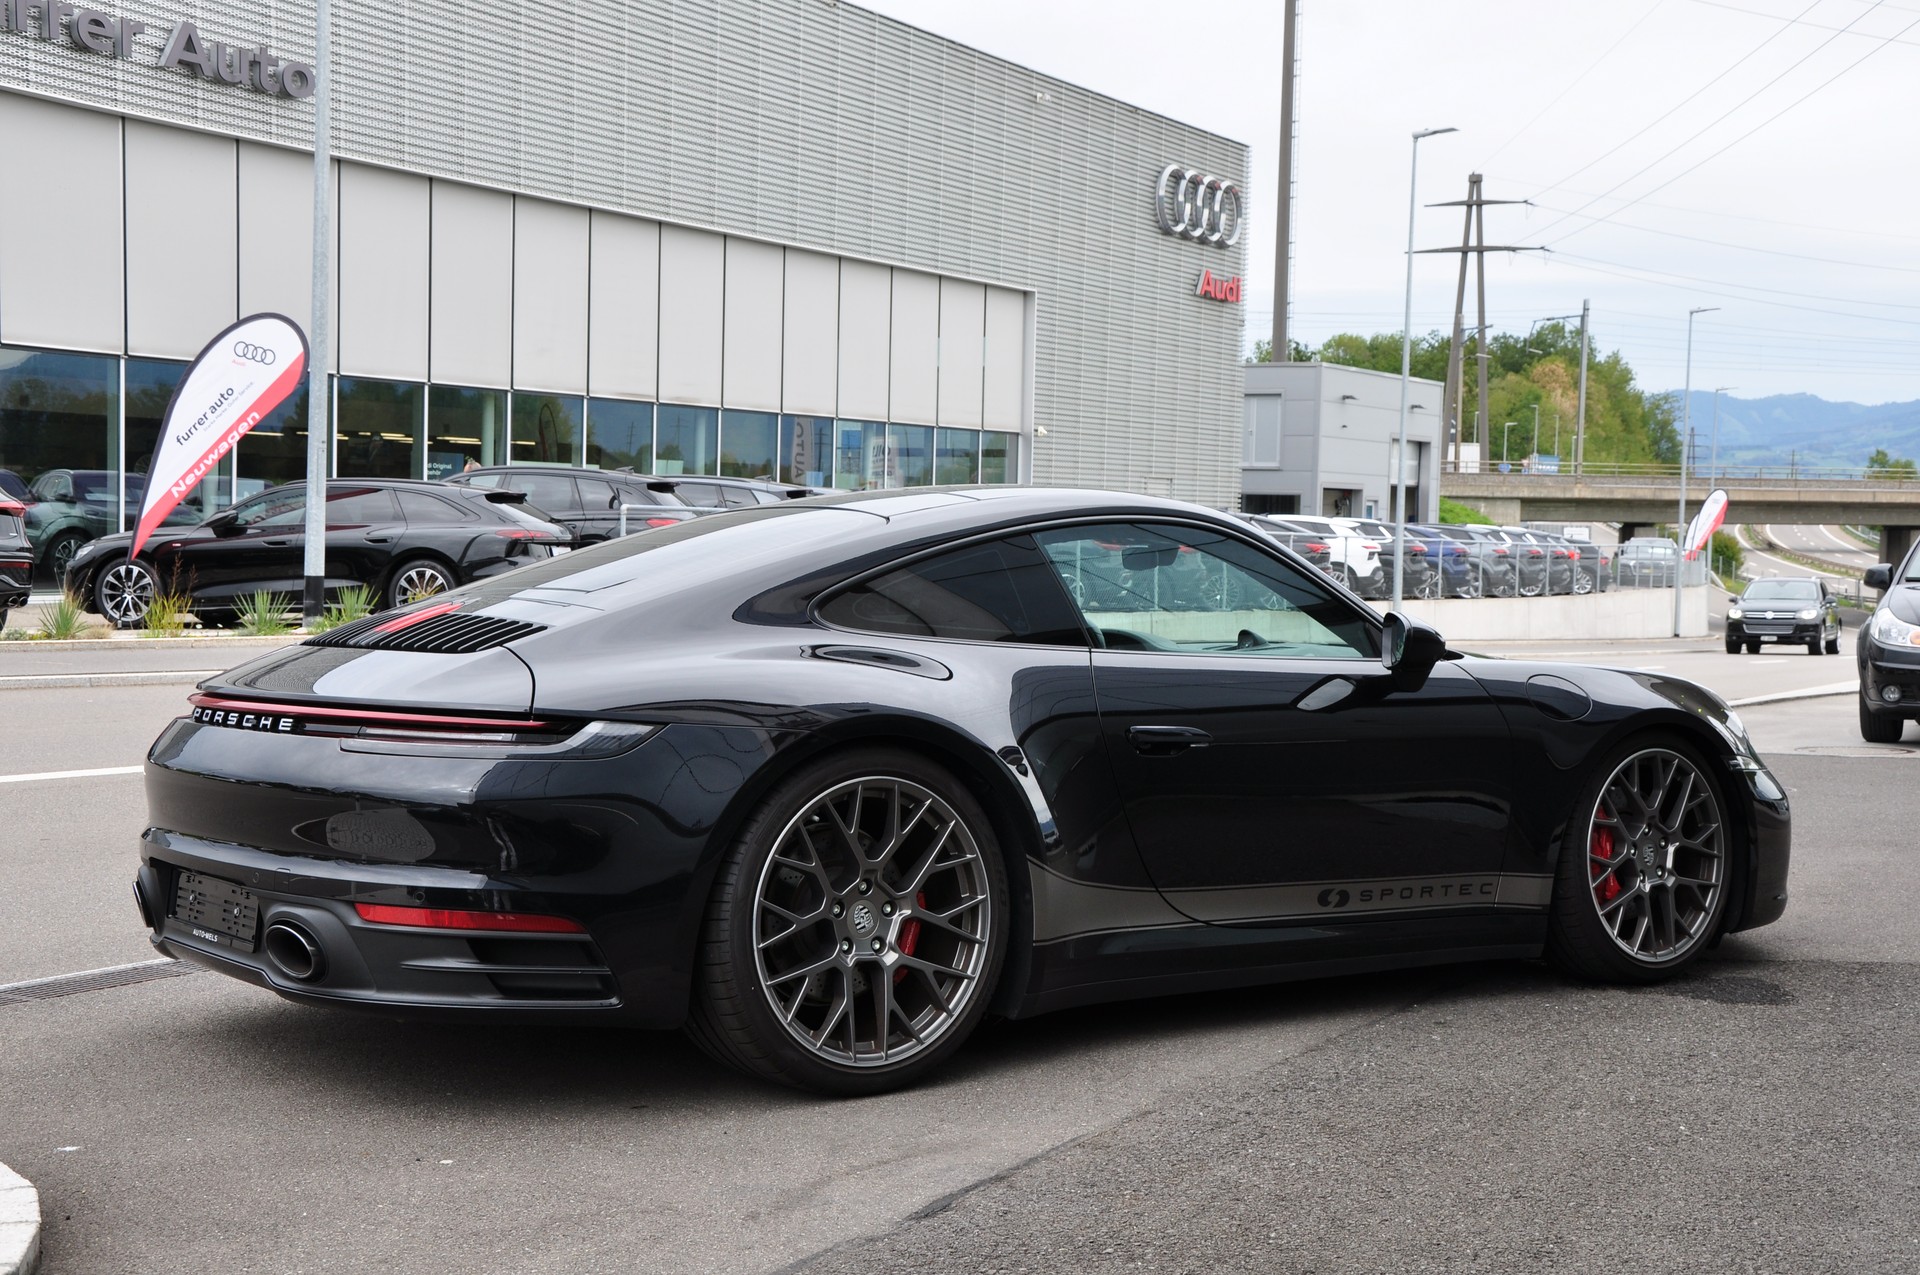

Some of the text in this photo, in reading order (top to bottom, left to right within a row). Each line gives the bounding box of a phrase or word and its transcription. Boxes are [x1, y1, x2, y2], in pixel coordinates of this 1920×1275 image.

[0, 0, 316, 99] rrer Auto
[1198, 269, 1242, 303] Audi
[176, 387, 234, 446] furrer auto
[171, 411, 260, 498] Neuwagen
[193, 707, 294, 731] PORSCHE
[1360, 882, 1494, 902] SPORTEC
